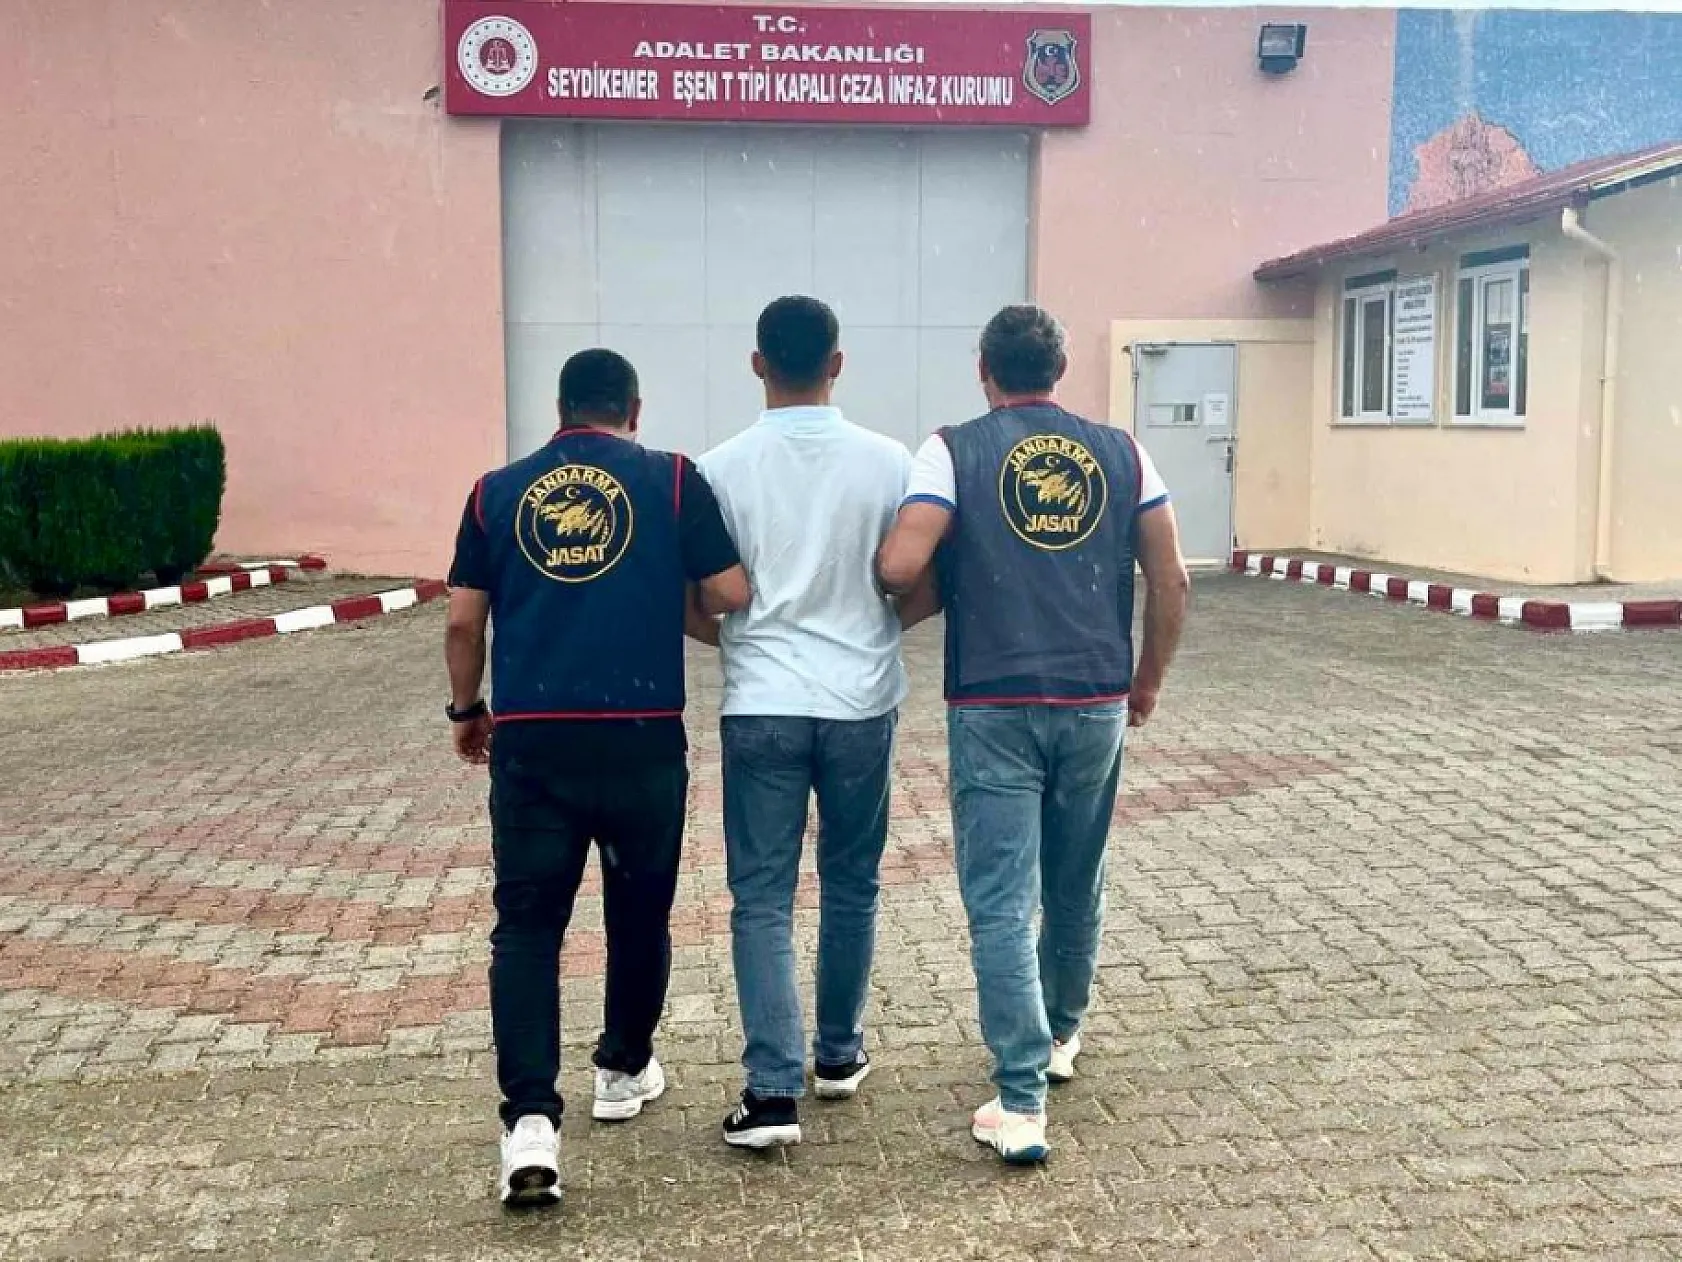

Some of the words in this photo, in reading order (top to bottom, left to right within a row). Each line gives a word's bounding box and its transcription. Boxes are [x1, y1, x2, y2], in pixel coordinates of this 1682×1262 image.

[752, 14, 806, 33] T.C.
[634, 41, 751, 60] ADALET
[761, 43, 926, 64] BAKANLIĞI
[548, 61, 660, 101] SEYDİKEMER
[673, 70, 717, 108] EŞEN
[721, 71, 735, 101] T
[737, 65, 772, 102] TİPİ
[775, 72, 836, 104] KAPALI
[840, 74, 885, 104] CEZA
[888, 67, 938, 106] İNFAZ
[941, 76, 1014, 106] KURUMU
[1010, 439, 1096, 473] JANDARMA
[527, 468, 620, 509] JANDARMA
[1024, 514, 1082, 533] JASAT
[546, 545, 607, 568] JASAT
